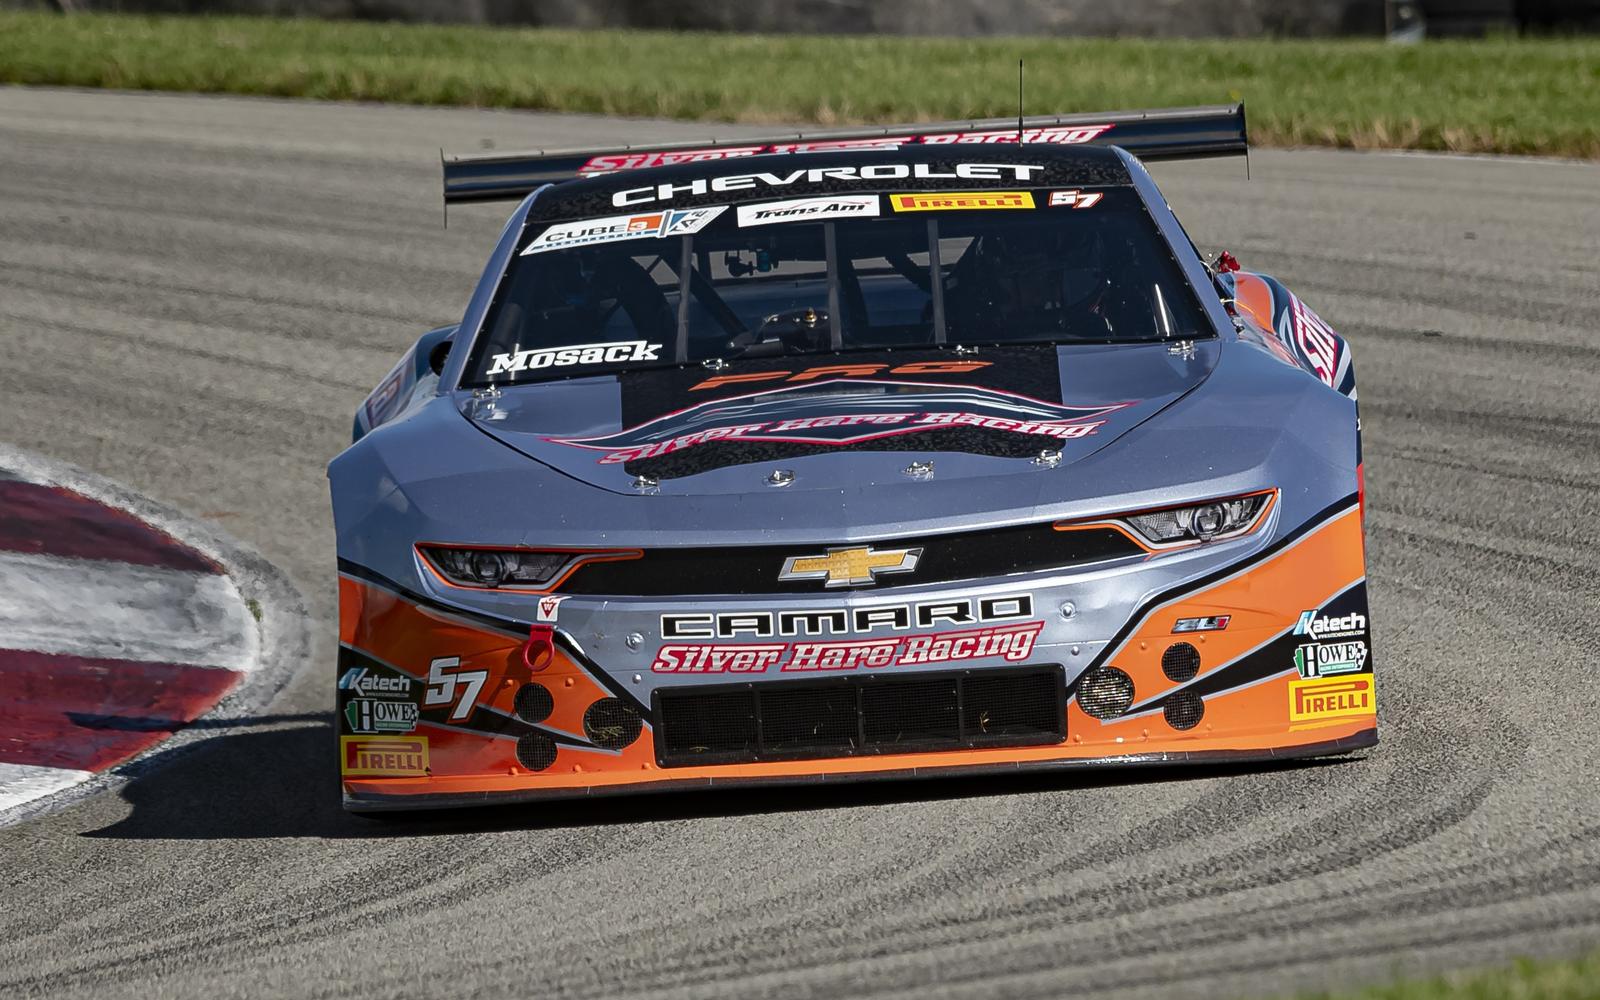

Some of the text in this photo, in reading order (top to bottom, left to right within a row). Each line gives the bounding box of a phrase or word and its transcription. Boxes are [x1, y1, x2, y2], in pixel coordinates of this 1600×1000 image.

[612, 163, 1045, 207] CHEVROLET
[899, 194, 1023, 208] PIRELLI
[1048, 190, 1104, 209] 57
[754, 203, 866, 219] Trans Am
[486, 340, 663, 375] Mosack
[598, 411, 1109, 465] Silver Hare Racing
[659, 592, 1034, 639] CAMARO
[1294, 609, 1367, 640] Katech
[652, 621, 1046, 673] Silver Hare Racing
[1300, 642, 1357, 678] HOWE
[341, 668, 411, 697] Katech
[423, 655, 490, 721] 57
[1295, 681, 1370, 715] PIRELLI
[353, 699, 413, 733] HOWE
[345, 741, 424, 770] PIRELLI
